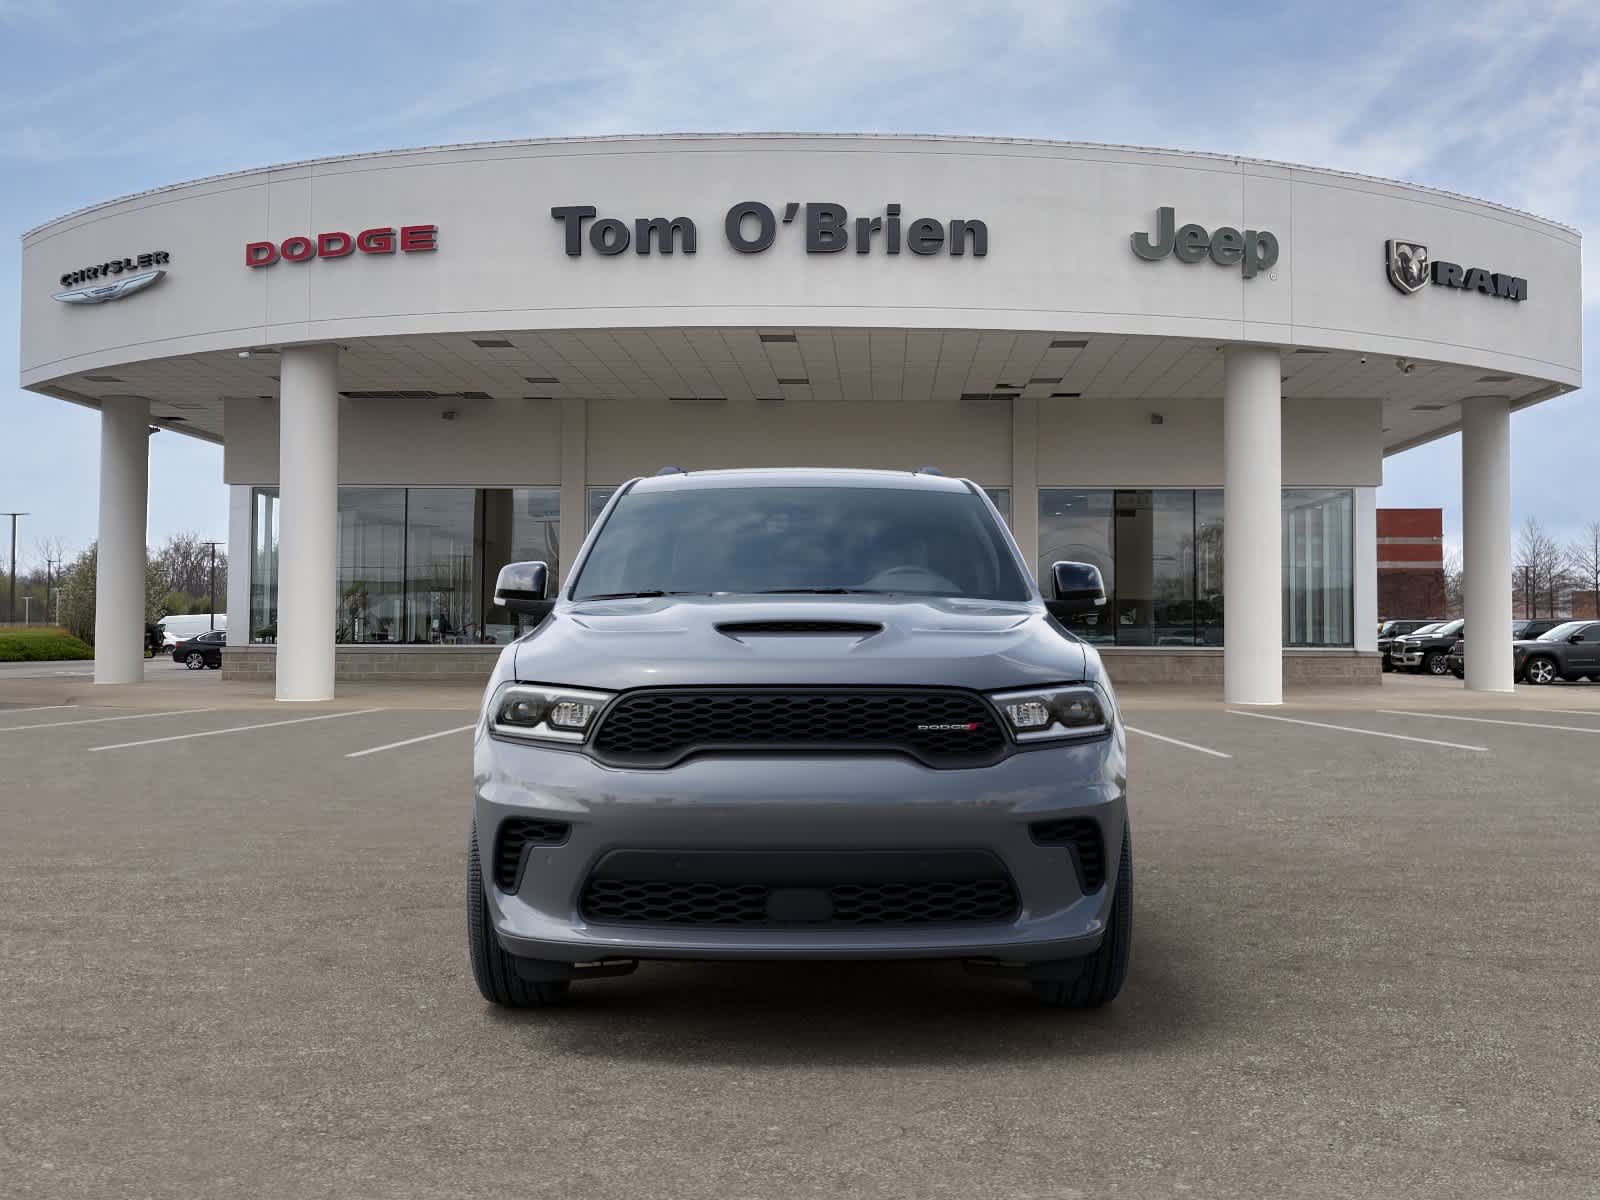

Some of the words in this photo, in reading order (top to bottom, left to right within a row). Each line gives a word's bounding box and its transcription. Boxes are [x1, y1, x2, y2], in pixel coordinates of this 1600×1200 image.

[246, 224, 438, 269] DODGE
[551, 205, 697, 257] Tom
[724, 201, 988, 257] O'Brien
[1130, 206, 1279, 279] Jeep
[60, 250, 170, 287] CHRYSLER
[1430, 260, 1528, 302] RAM
